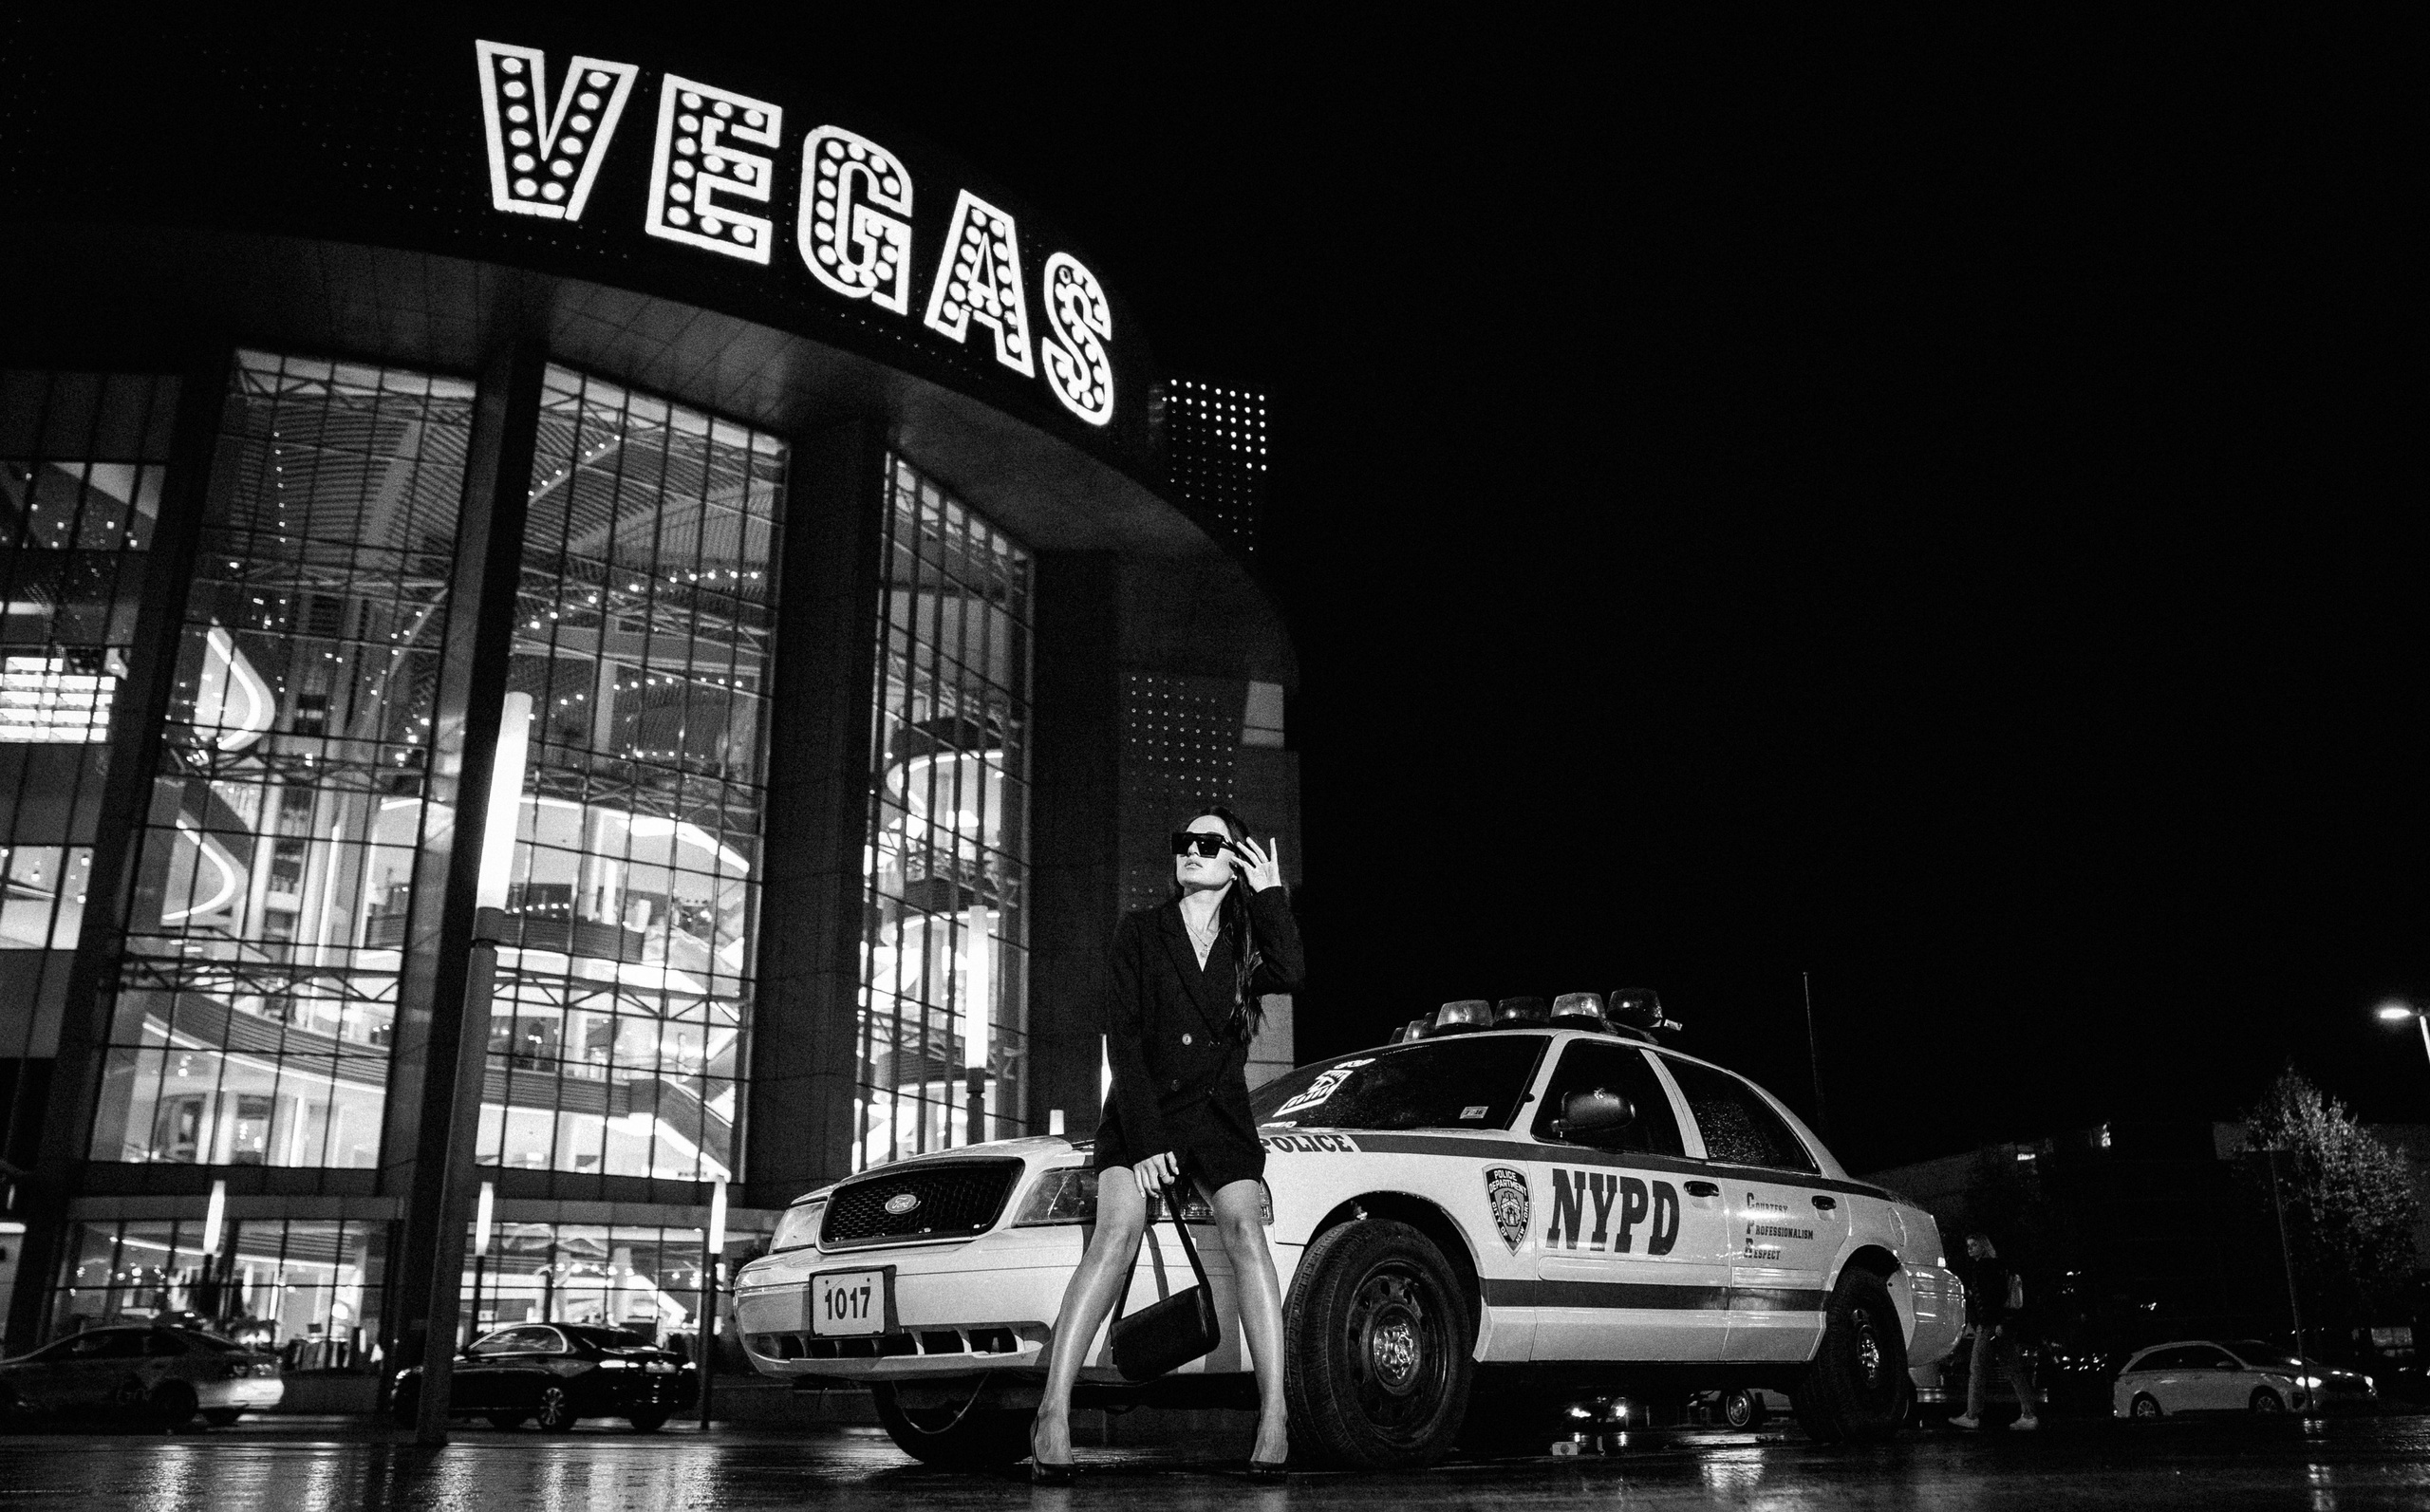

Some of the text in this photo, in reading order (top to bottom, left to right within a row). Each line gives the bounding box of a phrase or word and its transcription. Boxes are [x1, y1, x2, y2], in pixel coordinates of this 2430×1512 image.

[476, 39, 1113, 426] VEGAS
[1260, 1134, 1354, 1154] POLICE
[1493, 1169, 1518, 1182] POLICE
[1488, 1179, 1527, 1197] DEPARTMENT
[1491, 1201, 1508, 1237] CITY OF
[1545, 1167, 1680, 1256] NYPD
[1515, 1225, 1525, 1243] NEW
[1746, 1220, 1814, 1241] PROFESSIONALISM
[1743, 1238, 1781, 1260] RESPECT
[824, 1286, 871, 1320] 1017
